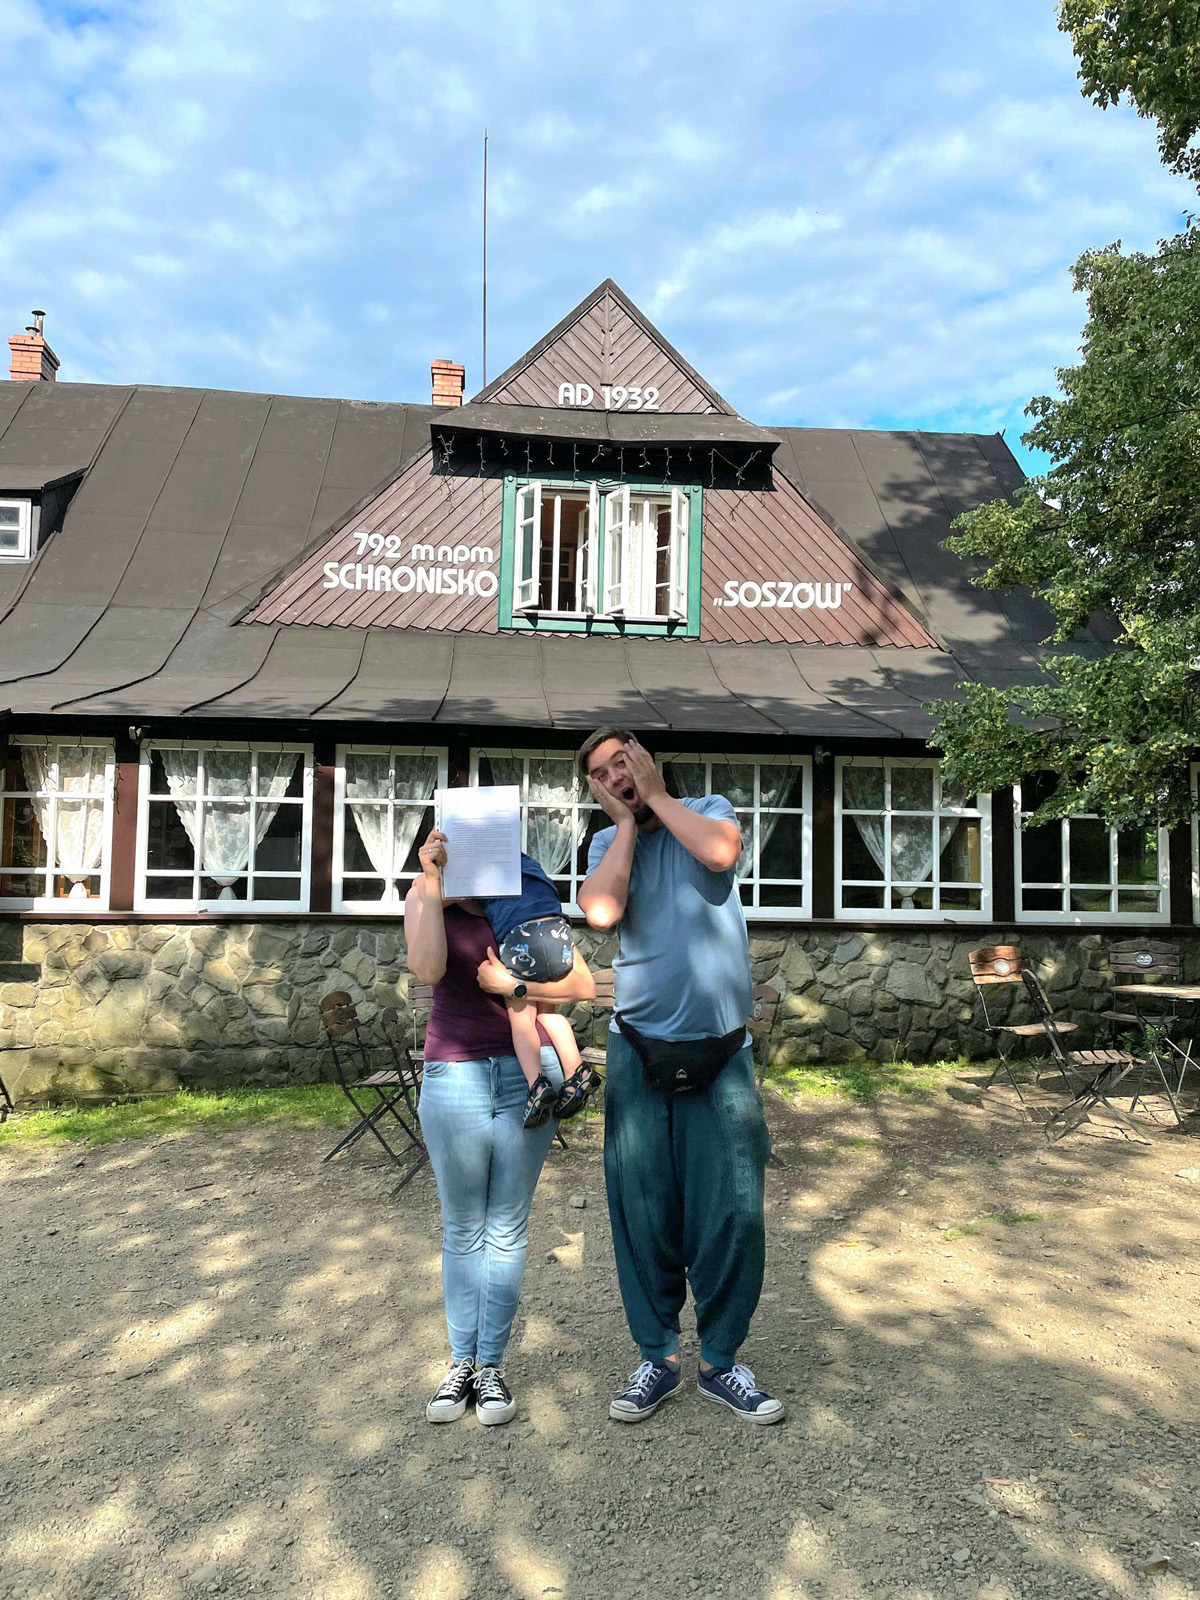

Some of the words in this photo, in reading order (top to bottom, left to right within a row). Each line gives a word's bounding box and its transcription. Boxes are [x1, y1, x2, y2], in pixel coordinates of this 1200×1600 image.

[558, 382, 594, 406] AD
[601, 386, 660, 410] 1932
[353, 532, 402, 559] 792
[322, 561, 499, 598] SCHRONISKO
